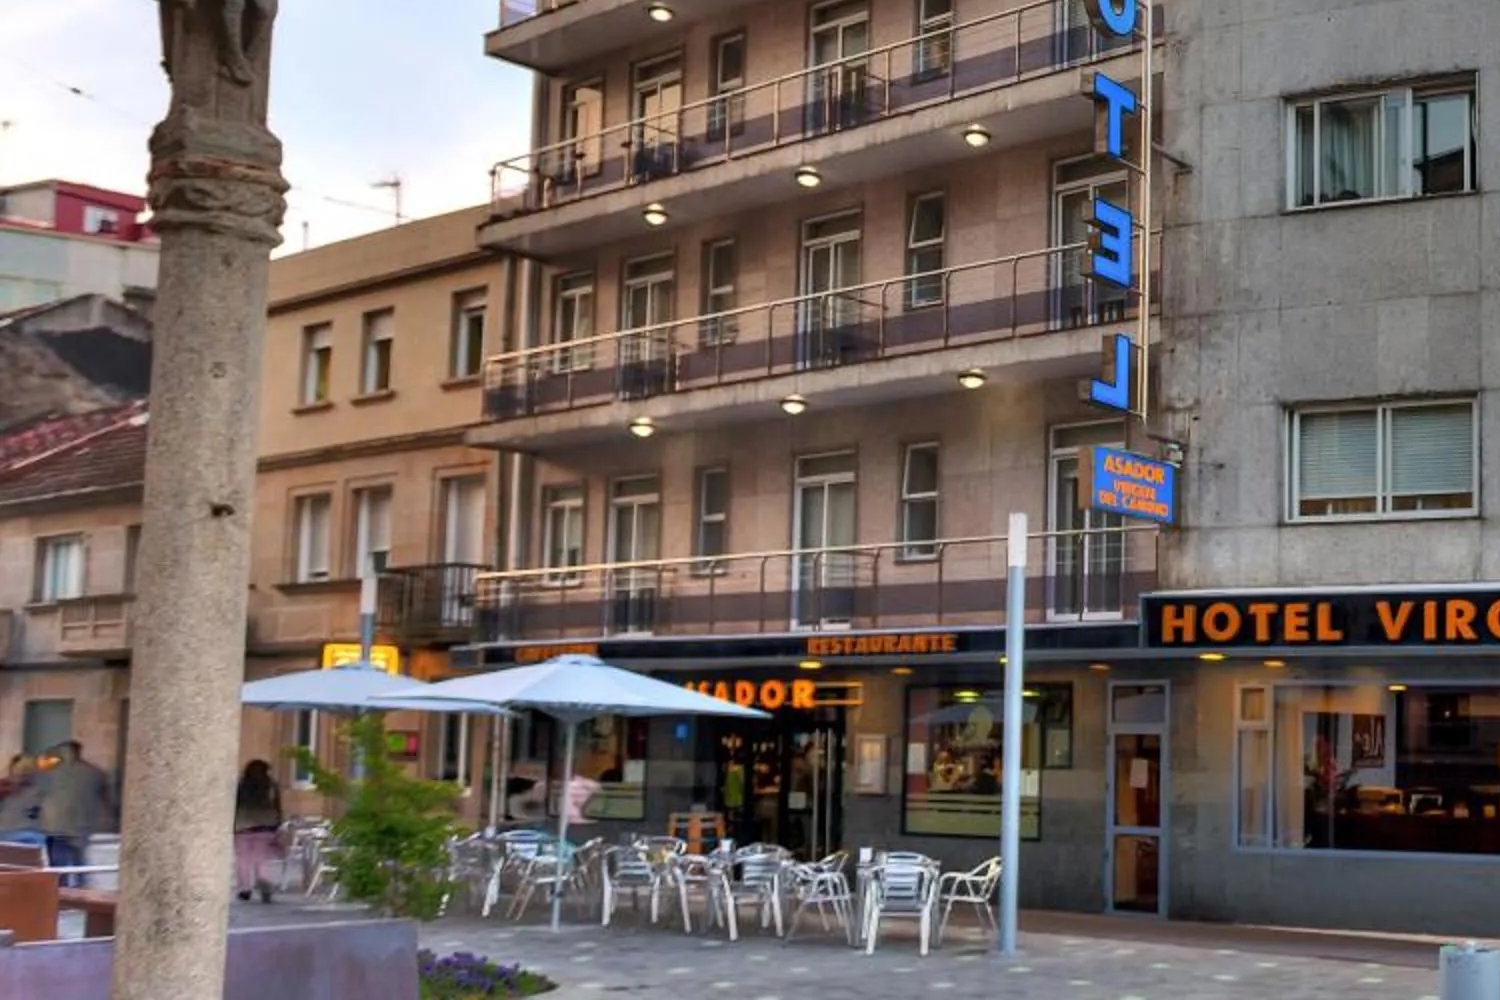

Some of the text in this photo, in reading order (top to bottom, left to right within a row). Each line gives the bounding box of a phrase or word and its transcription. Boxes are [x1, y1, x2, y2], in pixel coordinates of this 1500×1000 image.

[1104, 455, 1164, 484] ASADOR
[1161, 602, 1343, 642] HOTEL
[807, 634, 957, 654] RESTAURANTE
